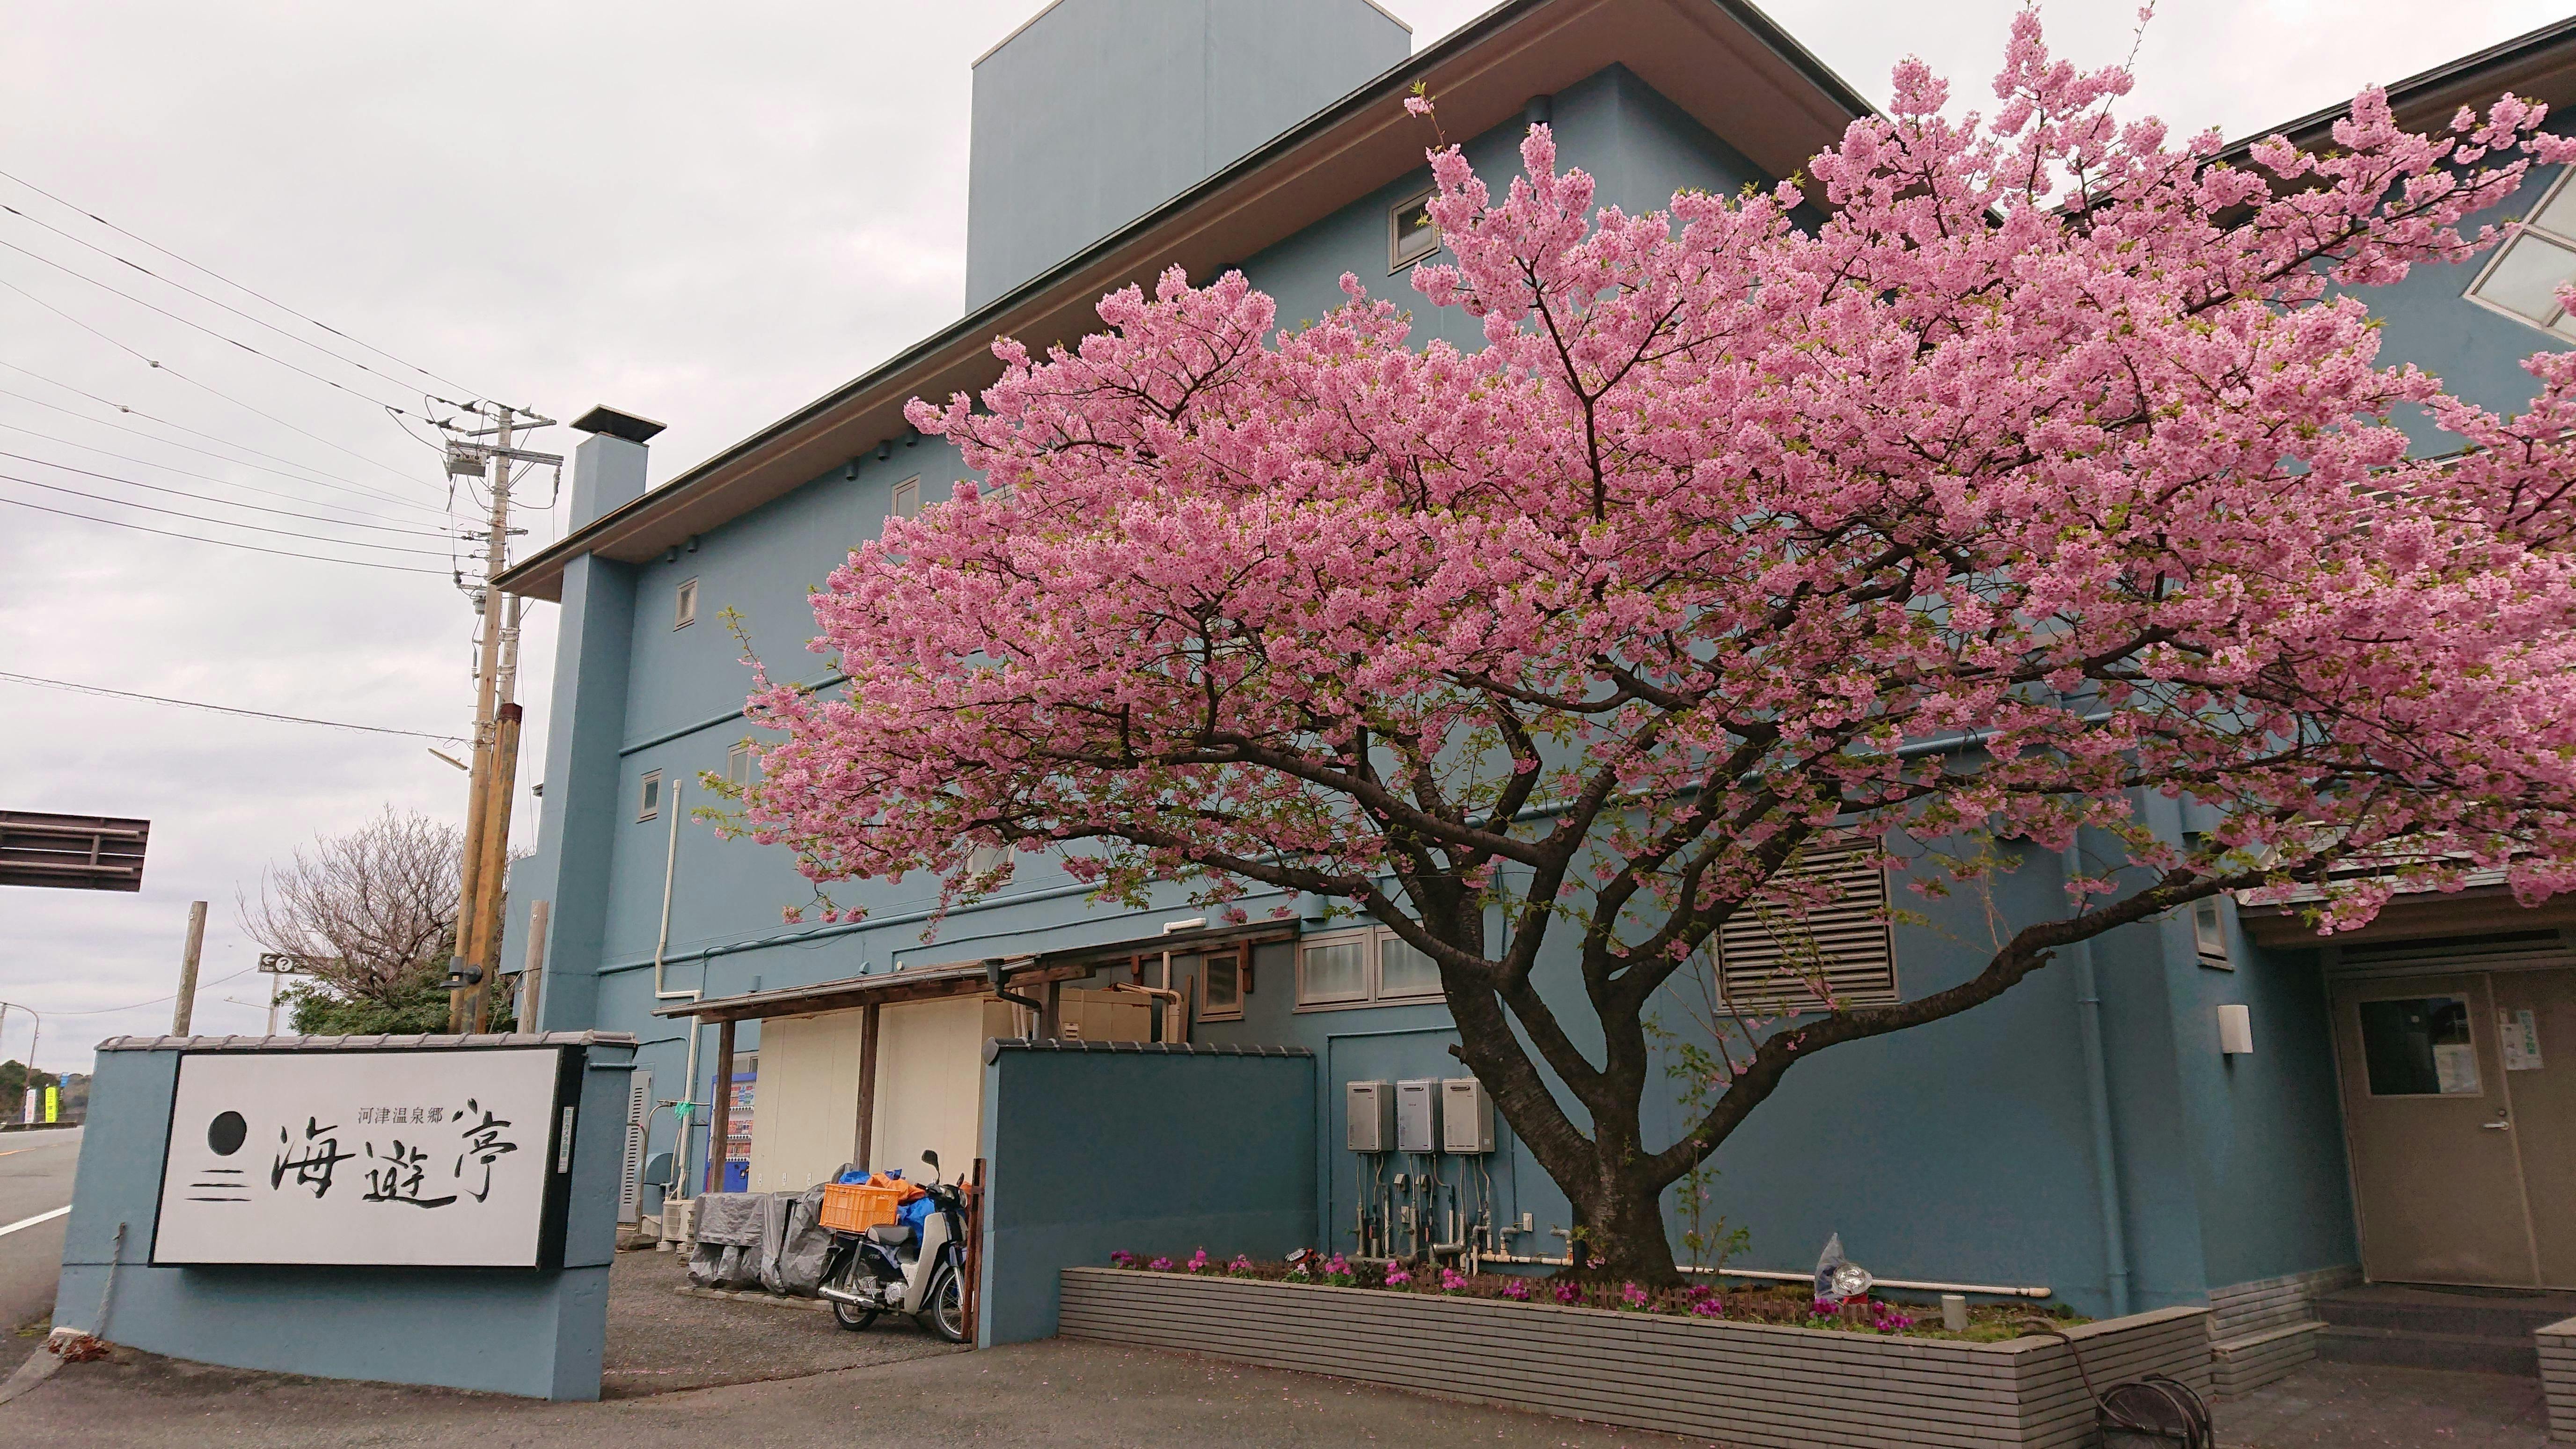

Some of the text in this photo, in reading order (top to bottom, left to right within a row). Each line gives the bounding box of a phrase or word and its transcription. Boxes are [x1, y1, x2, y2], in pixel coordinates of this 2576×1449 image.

[357, 1107, 444, 1124] 河津温泉郷
[271, 1098, 518, 1208] 海遊亭
